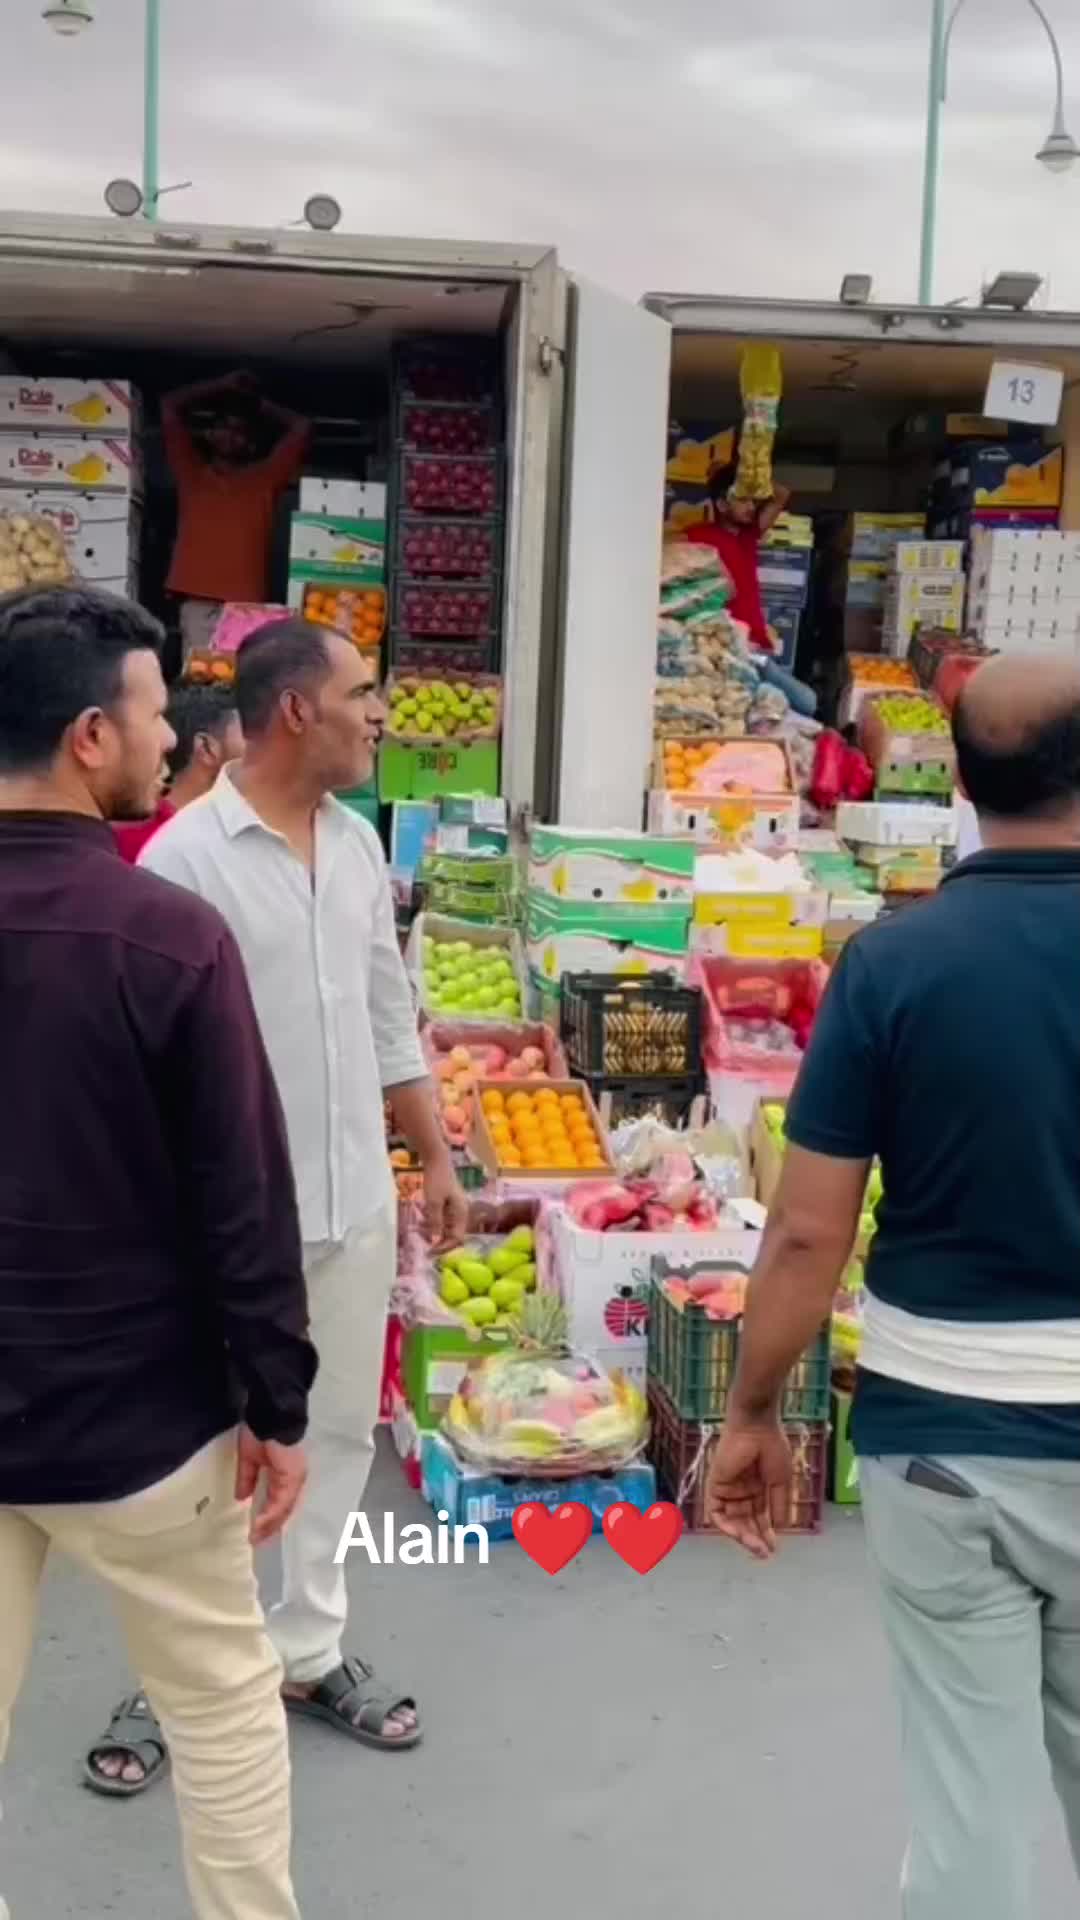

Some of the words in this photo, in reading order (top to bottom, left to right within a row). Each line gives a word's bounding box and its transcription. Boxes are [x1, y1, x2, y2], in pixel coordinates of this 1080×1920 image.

[19, 386, 54, 405] Dole
[1009, 377, 1035, 405] 13
[18, 448, 53, 466] Dole
